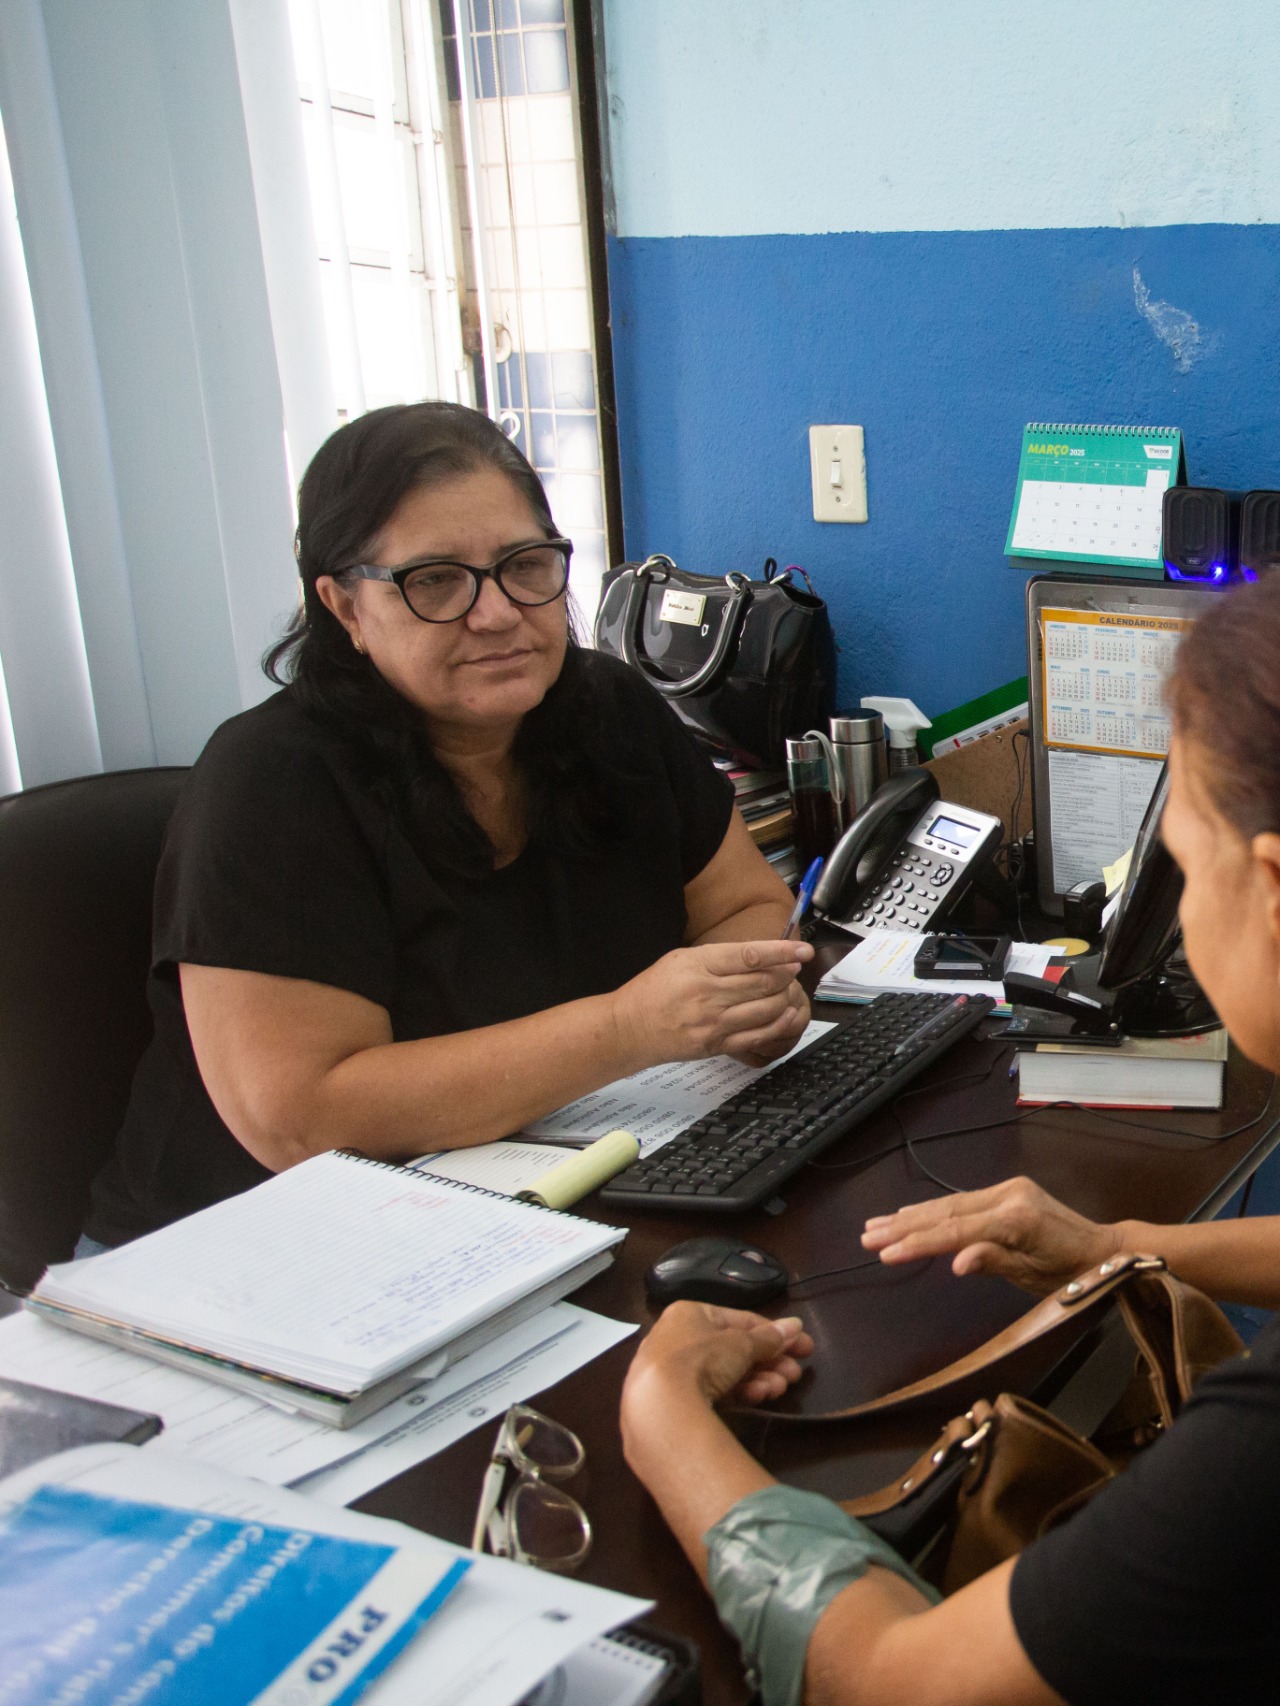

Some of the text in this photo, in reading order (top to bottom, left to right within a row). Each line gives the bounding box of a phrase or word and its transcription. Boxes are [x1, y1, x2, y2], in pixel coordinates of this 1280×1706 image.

[1027, 443, 1085, 458] MARÇO 2025
[581, 1102, 638, 1133] Não Aplicável
[632, 1106, 656, 1120] 0800
[652, 1110, 676, 1124] 0800
[672, 1114, 696, 1128] 0800
[211, 1531, 313, 1623] Direitos
[173, 1622, 216, 1658] do
